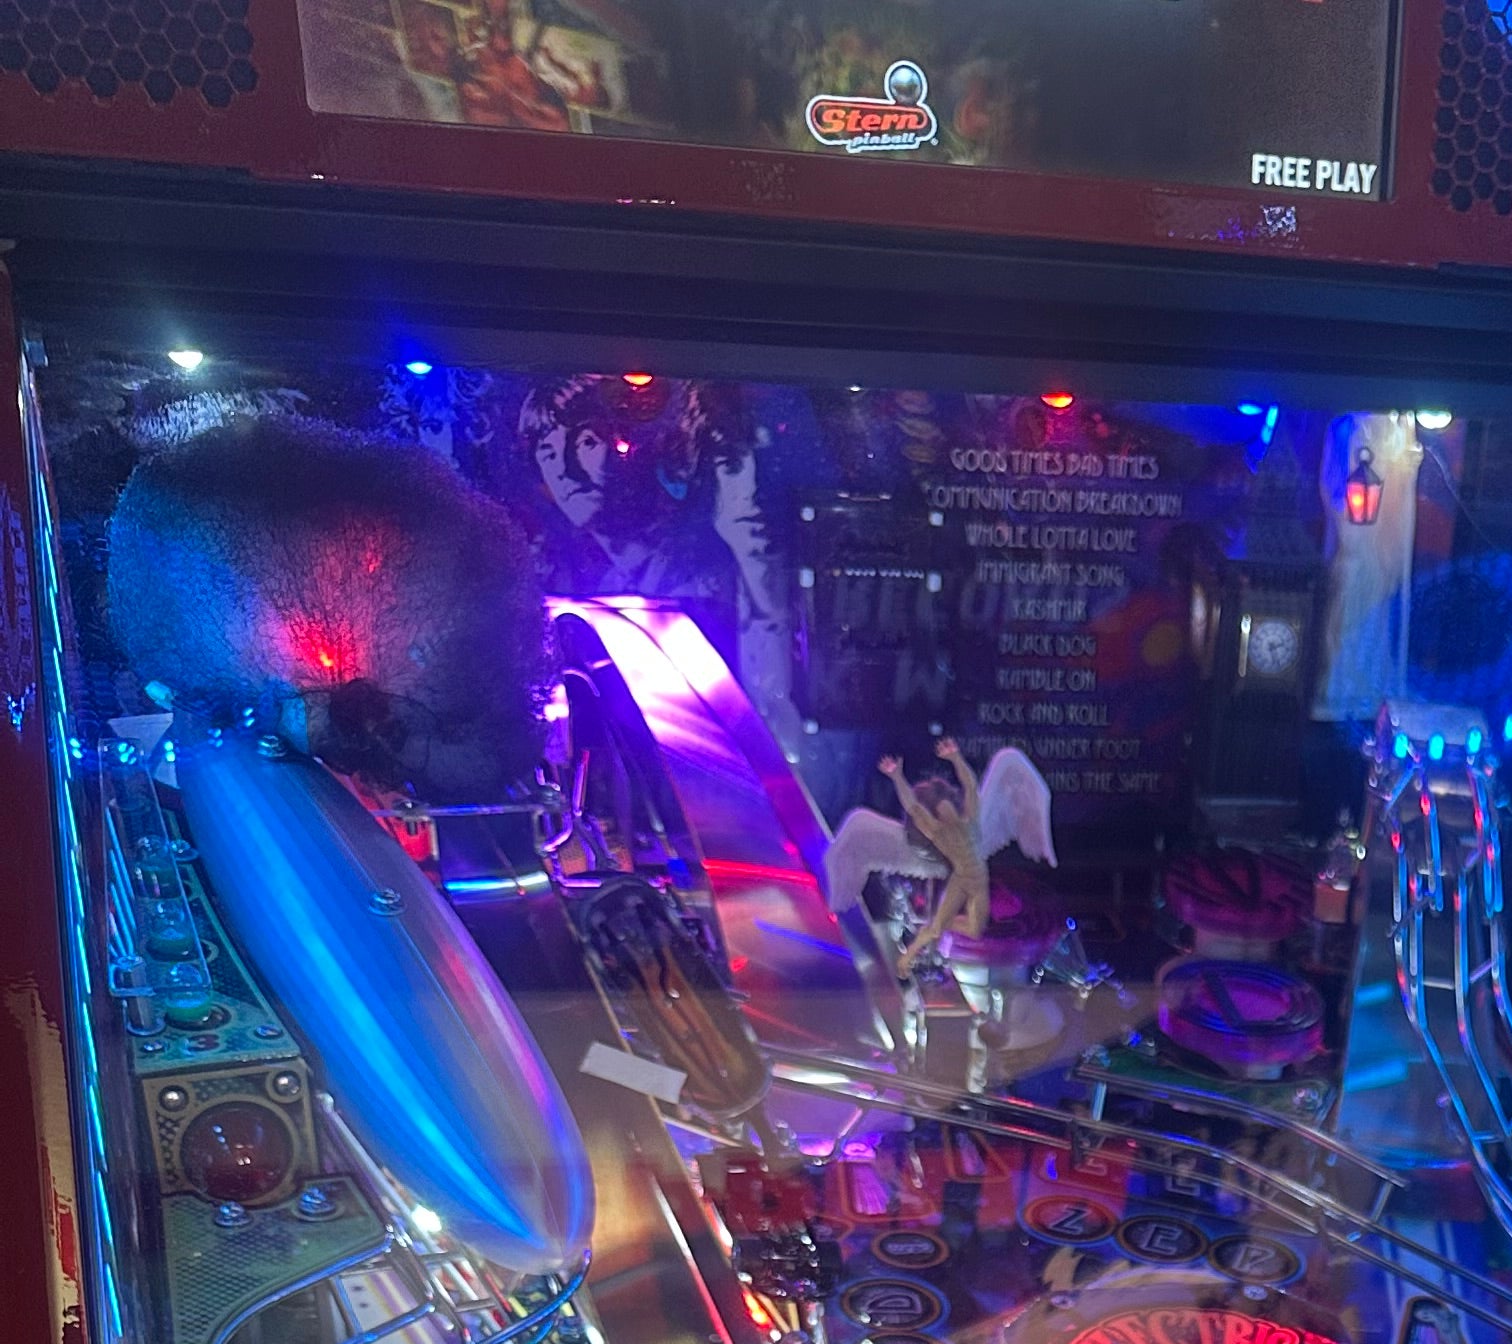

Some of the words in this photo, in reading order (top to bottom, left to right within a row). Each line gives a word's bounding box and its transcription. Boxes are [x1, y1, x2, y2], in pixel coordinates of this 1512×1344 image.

[822, 108, 919, 133] Stern
[851, 132, 916, 147] pinball
[1251, 153, 1311, 190] FREE
[1315, 159, 1378, 195] PLAY
